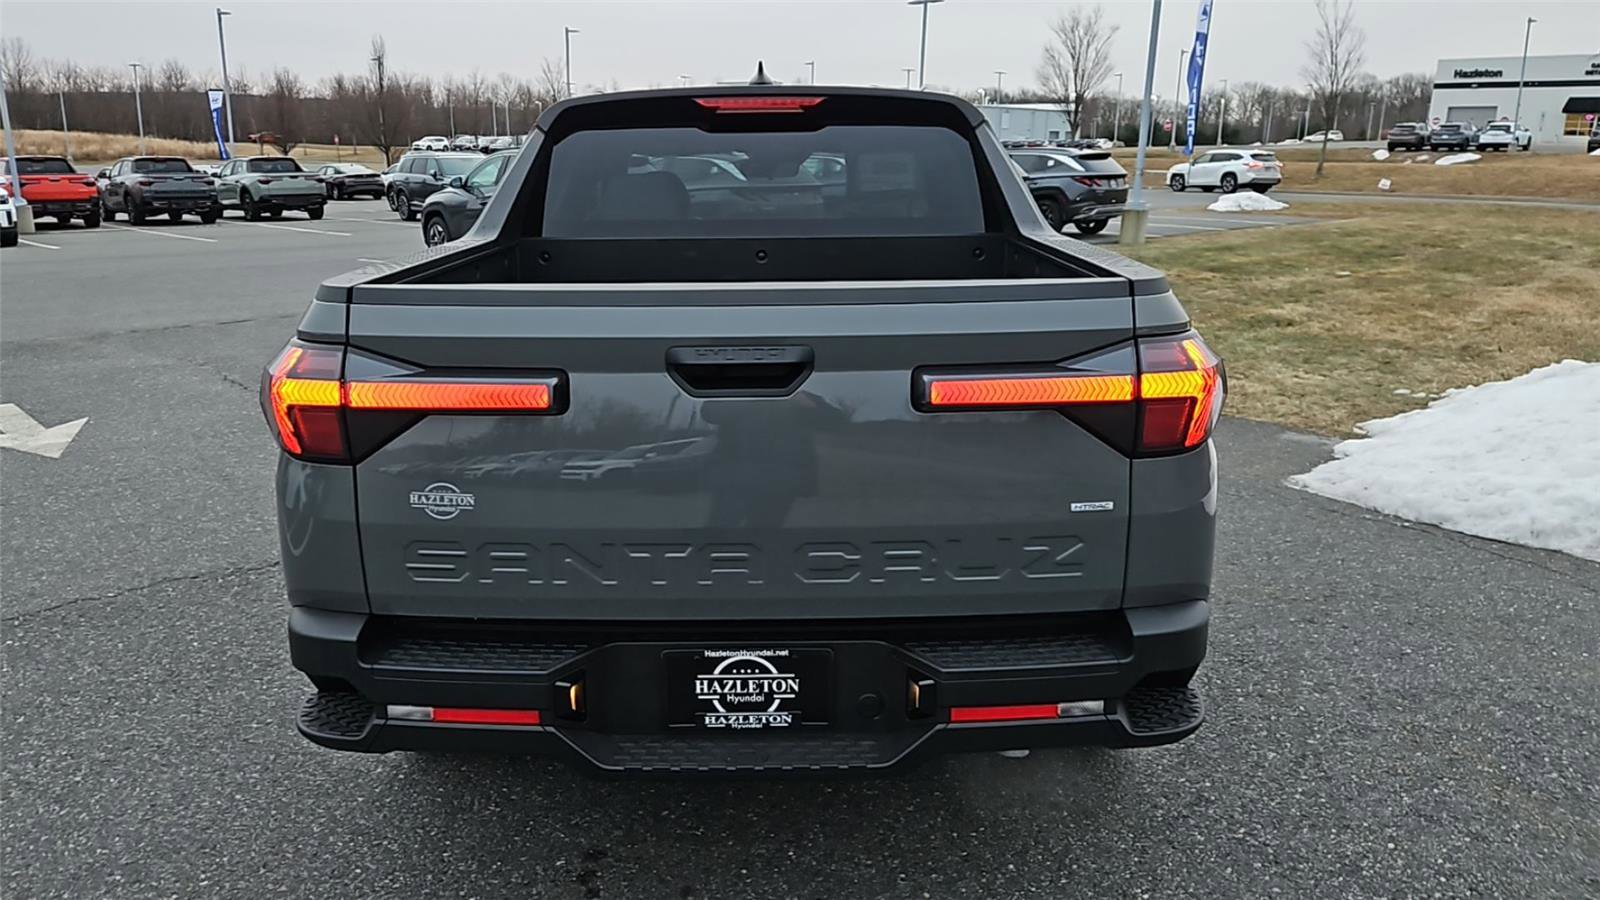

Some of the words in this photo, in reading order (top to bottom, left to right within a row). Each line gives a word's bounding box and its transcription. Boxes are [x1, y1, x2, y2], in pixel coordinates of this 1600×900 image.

[1453, 68, 1503, 79] Hazleton
[695, 347, 785, 361] HYUNDAI
[409, 494, 475, 505] HAZLETON
[404, 540, 763, 585] SANTA
[793, 535, 1085, 583] CRUZ
[704, 649, 789, 658] HazletonHyundai.net
[695, 678, 800, 694] HAZLETON
[726, 693, 765, 704] Hyundai
[704, 714, 792, 724] HAZLETON
